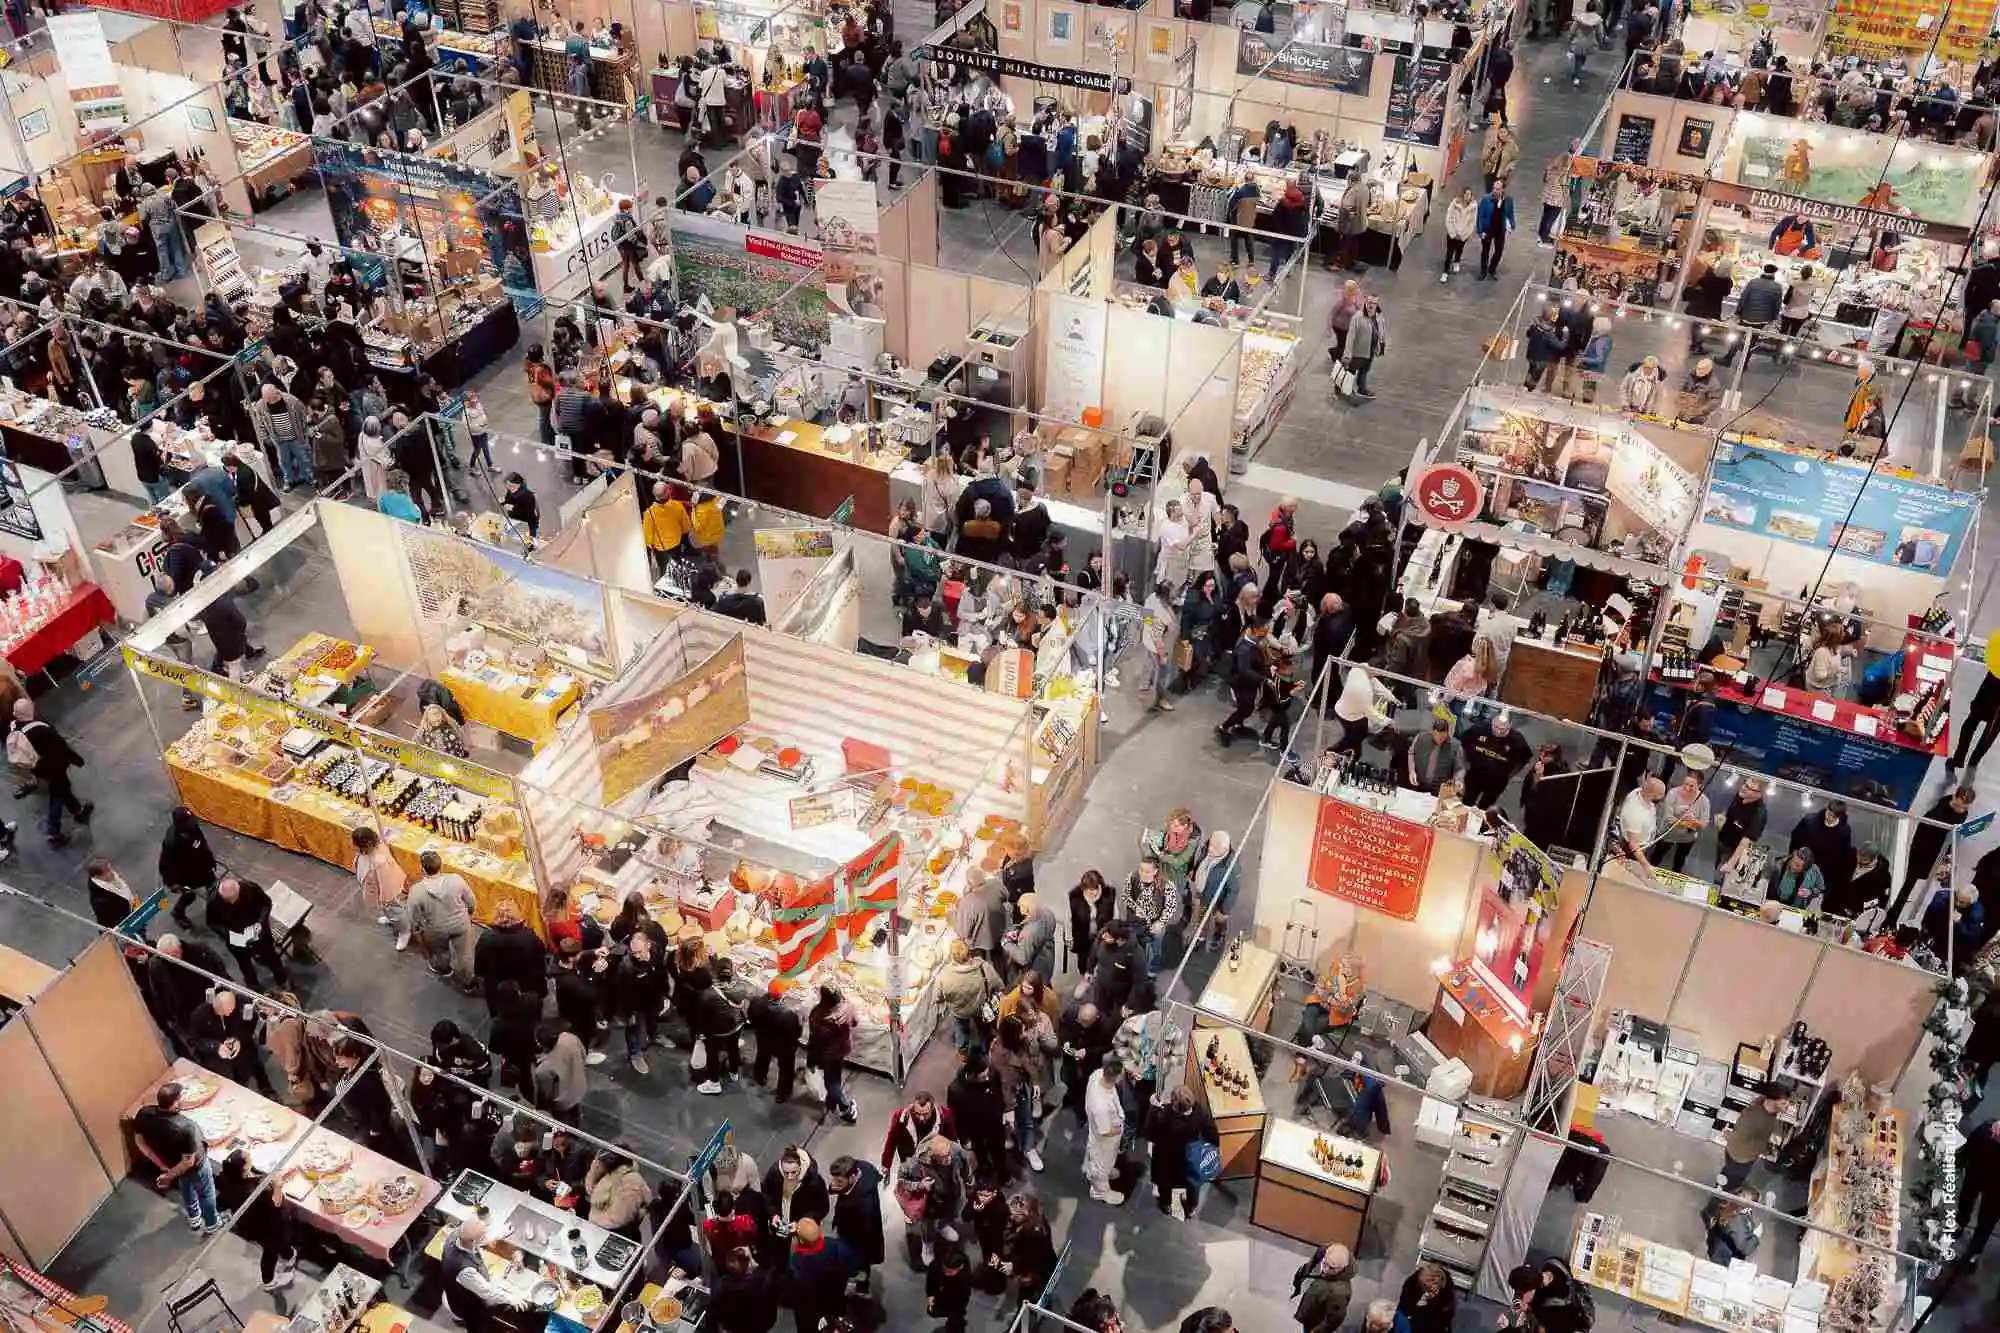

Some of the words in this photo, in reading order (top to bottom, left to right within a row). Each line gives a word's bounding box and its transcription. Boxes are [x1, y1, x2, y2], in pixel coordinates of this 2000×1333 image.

[937, 49, 998, 70] DOMAINE
[1749, 190, 1829, 217] FROMAGES
[1834, 205, 1928, 236] D'AUVERGNE
